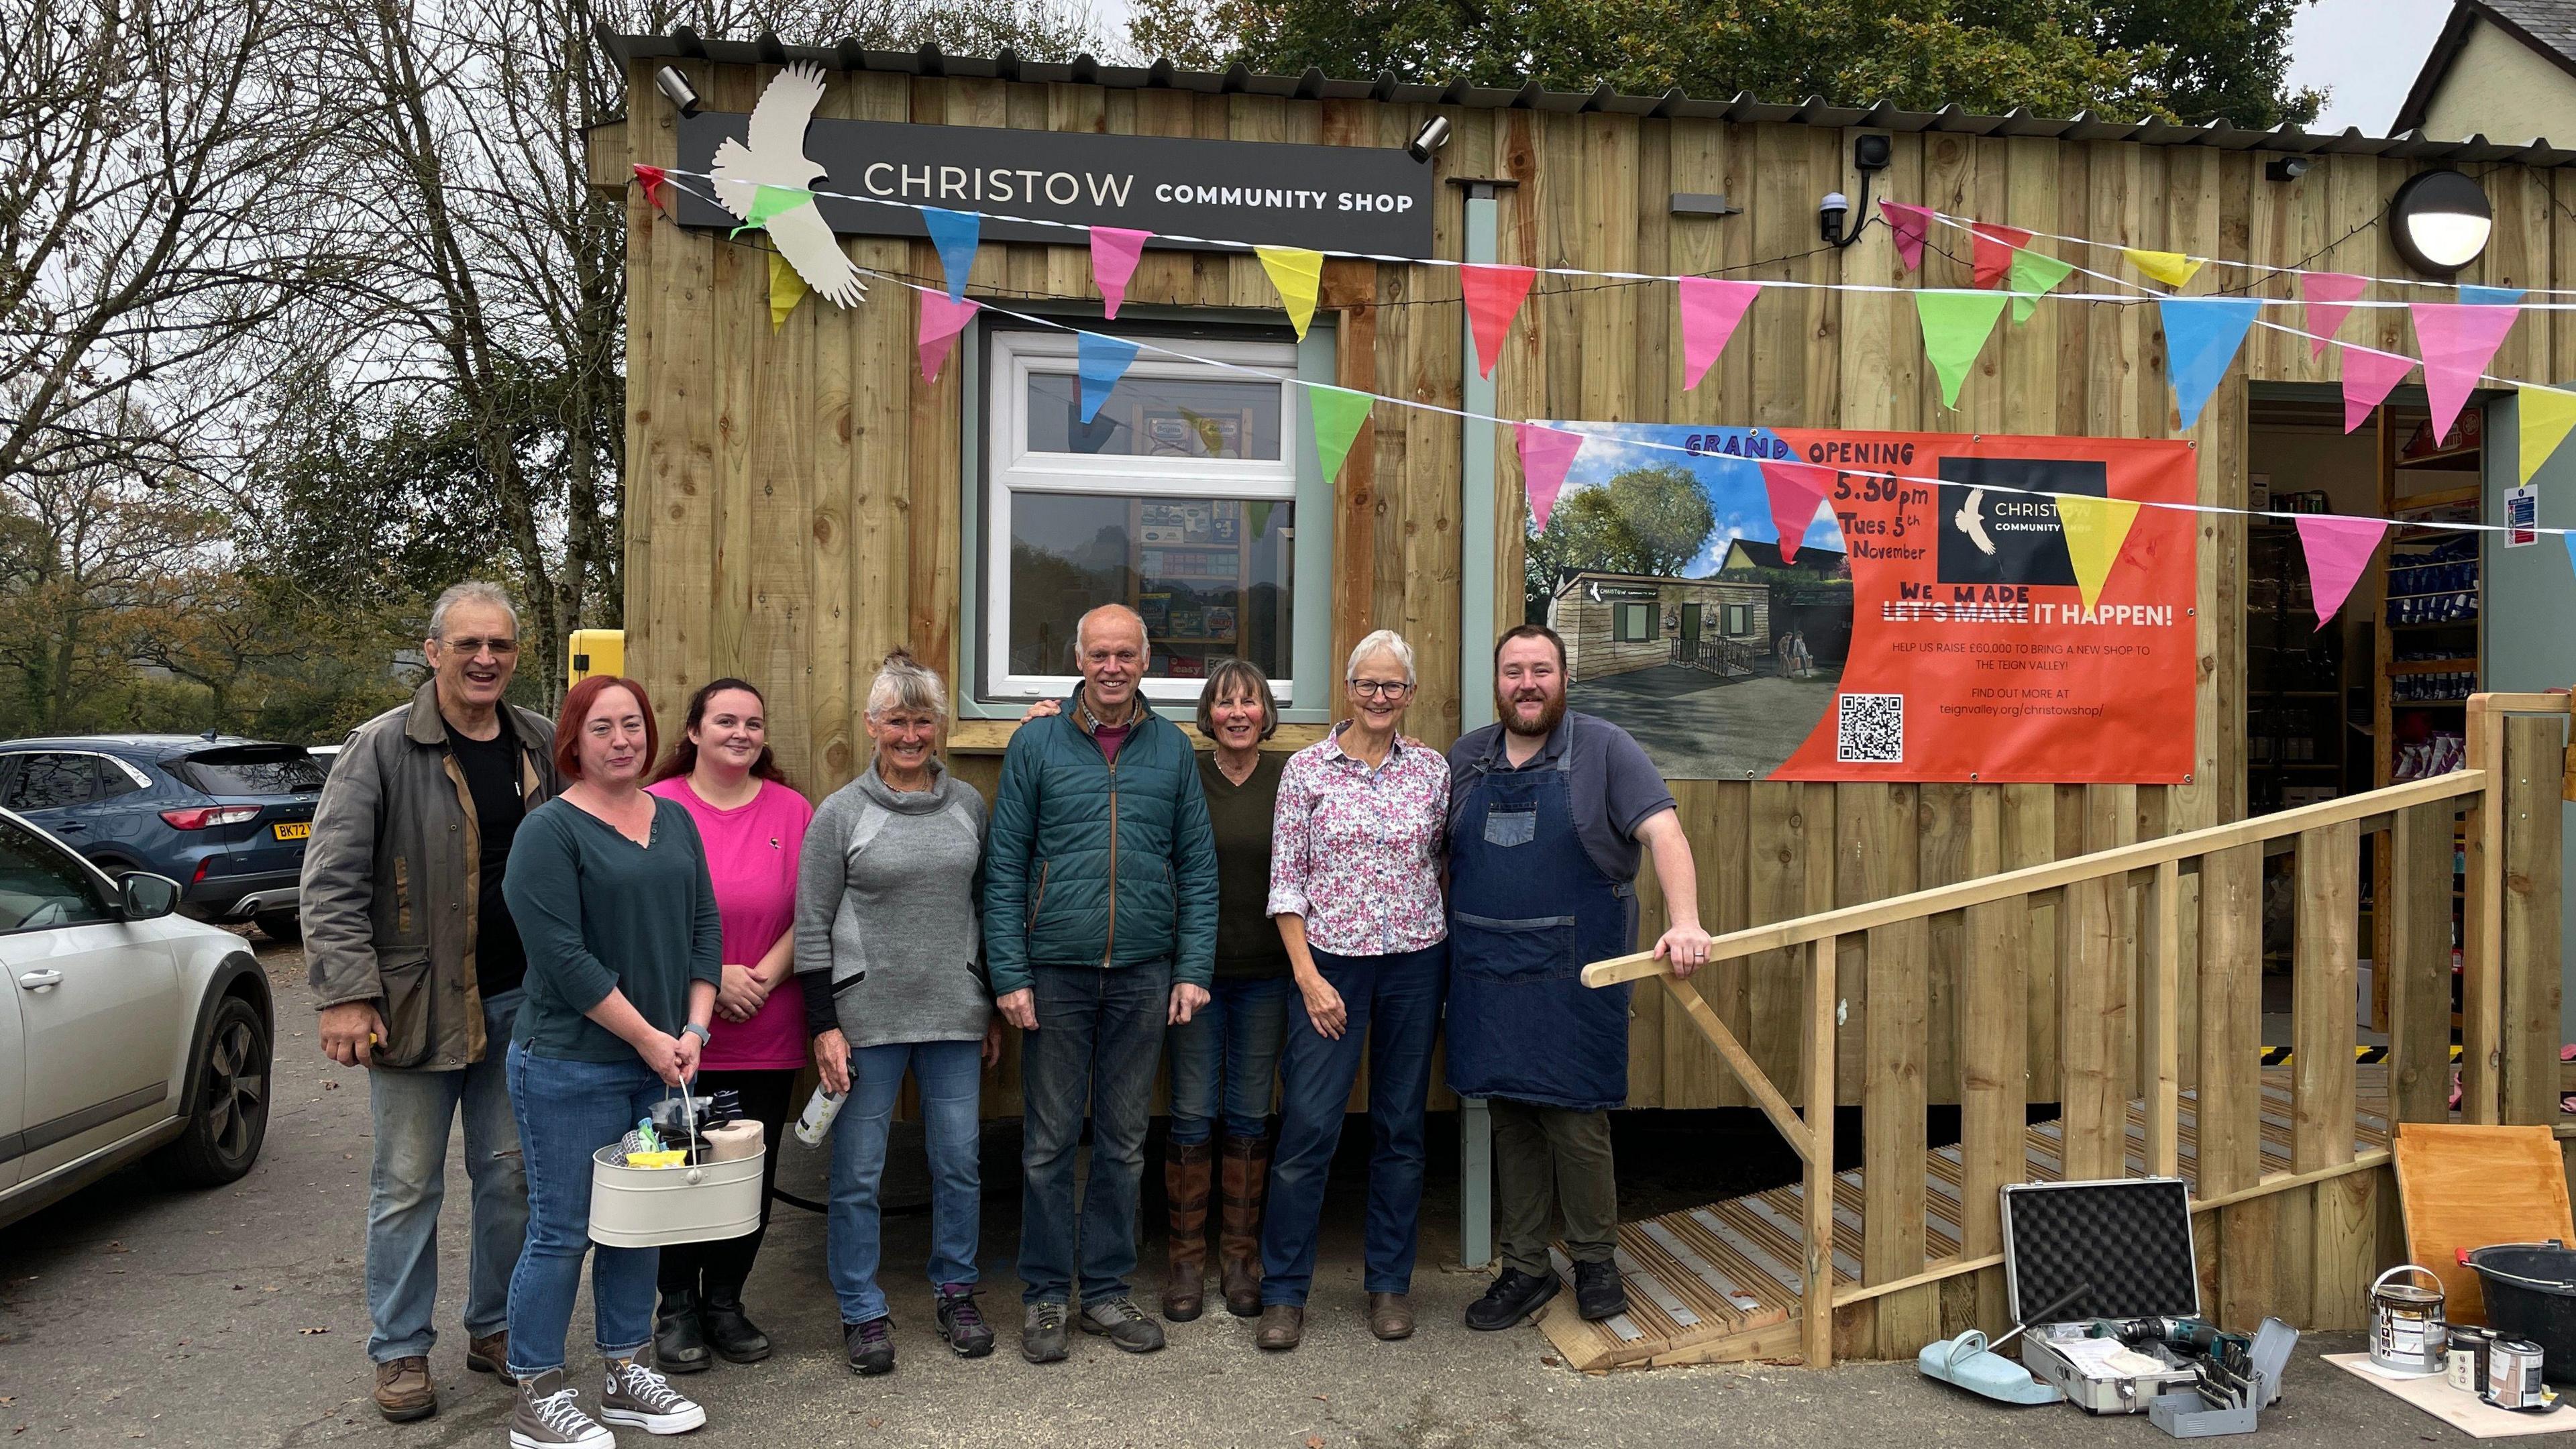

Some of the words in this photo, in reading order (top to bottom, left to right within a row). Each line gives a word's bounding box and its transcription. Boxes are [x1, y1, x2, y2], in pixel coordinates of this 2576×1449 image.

[863, 162, 1135, 207] CHRISTOW
[1155, 183, 1328, 210] COMMUNITY
[1337, 192, 1413, 213] SHOP
[1684, 434, 1789, 460] GRAND
[1809, 441, 1915, 466] OPENING
[1833, 470, 1929, 516] 5.30pm
[1837, 512, 1889, 535] Tues.
[1892, 514, 1921, 537] 5th
[1994, 523, 2061, 533] COMMUNITY
[1853, 539, 1927, 560] November
[1900, 581, 1933, 600] WE
[1953, 585, 2029, 603] MADE
[1883, 600, 1948, 623] LET'S
[1954, 602, 2029, 624] MAKE
[2034, 604, 2056, 624] IT
[2061, 604, 2173, 627] HAPPEN!
[1892, 643, 1916, 652] HELP
[1919, 643, 1933, 652] US
[1937, 643, 1965, 653] RAISE
[1970, 643, 2012, 654] £60,000
[2015, 644, 2029, 654] TO
[2031, 644, 2063, 654] BRING
[2067, 645, 2074, 654] A
[2077, 645, 2100, 655] NEW
[2104, 645, 2133, 655] SHOP
[2137, 645, 2151, 655] TO
[1976, 659, 1994, 669] THE
[1998, 660, 2026, 670] TEIGN
[2029, 661, 2068, 671] VALLEY!
[1972, 688, 1994, 698] FIND
[1997, 688, 2019, 698] OUT
[2022, 689, 2053, 699] MORE
[2056, 689, 2070, 699] AT
[1939, 702, 2104, 718] teignvalley.org/christowshop/
[278, 824, 307, 837] BK72
